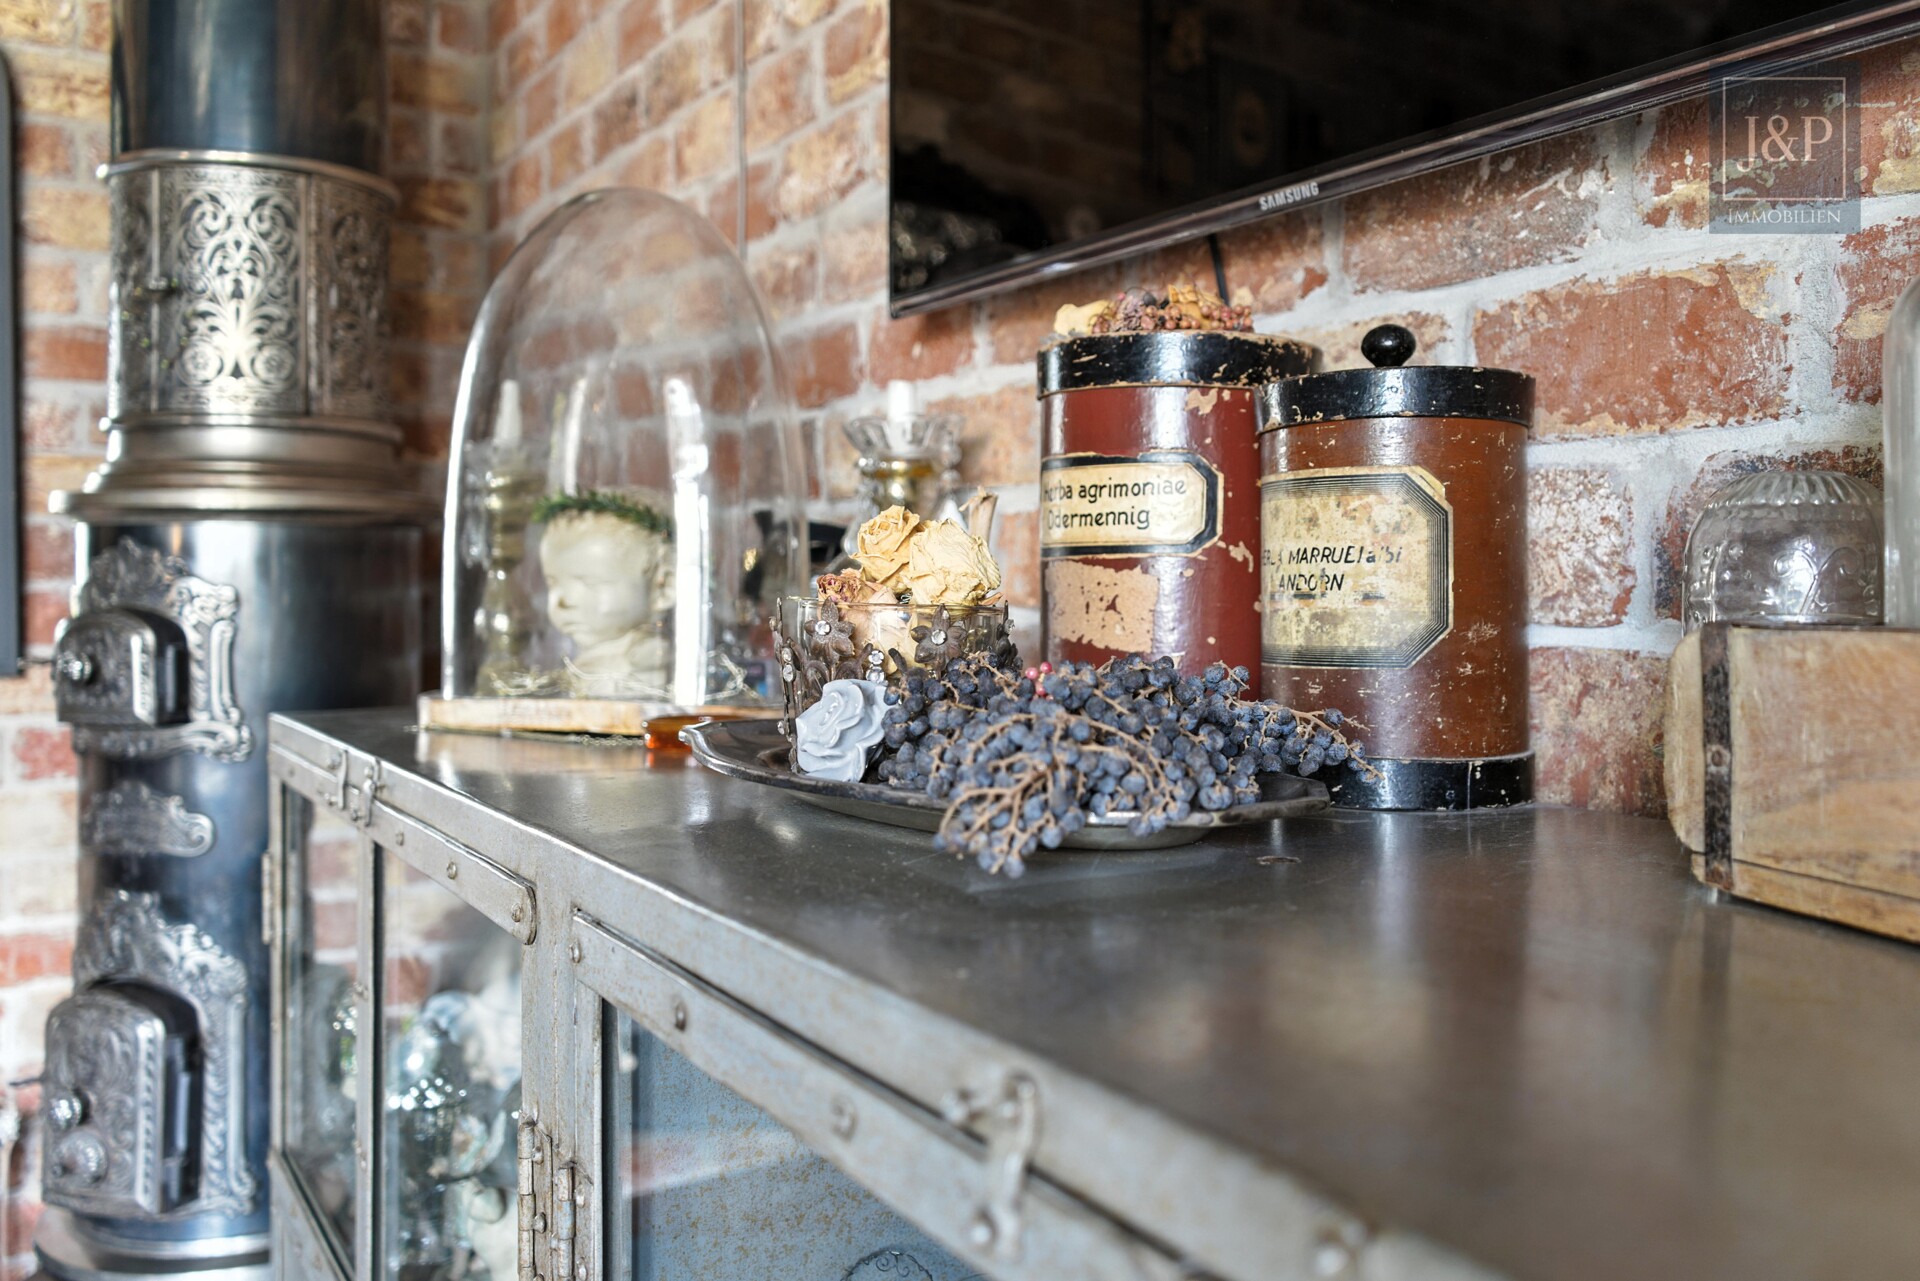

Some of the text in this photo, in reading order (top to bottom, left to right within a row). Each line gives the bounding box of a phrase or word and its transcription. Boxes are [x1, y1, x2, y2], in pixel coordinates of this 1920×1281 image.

[1259, 181, 1319, 211] SAMSUNG
[1078, 475, 1187, 504] agrimoniae
[1048, 505, 1150, 530] Odermennig
